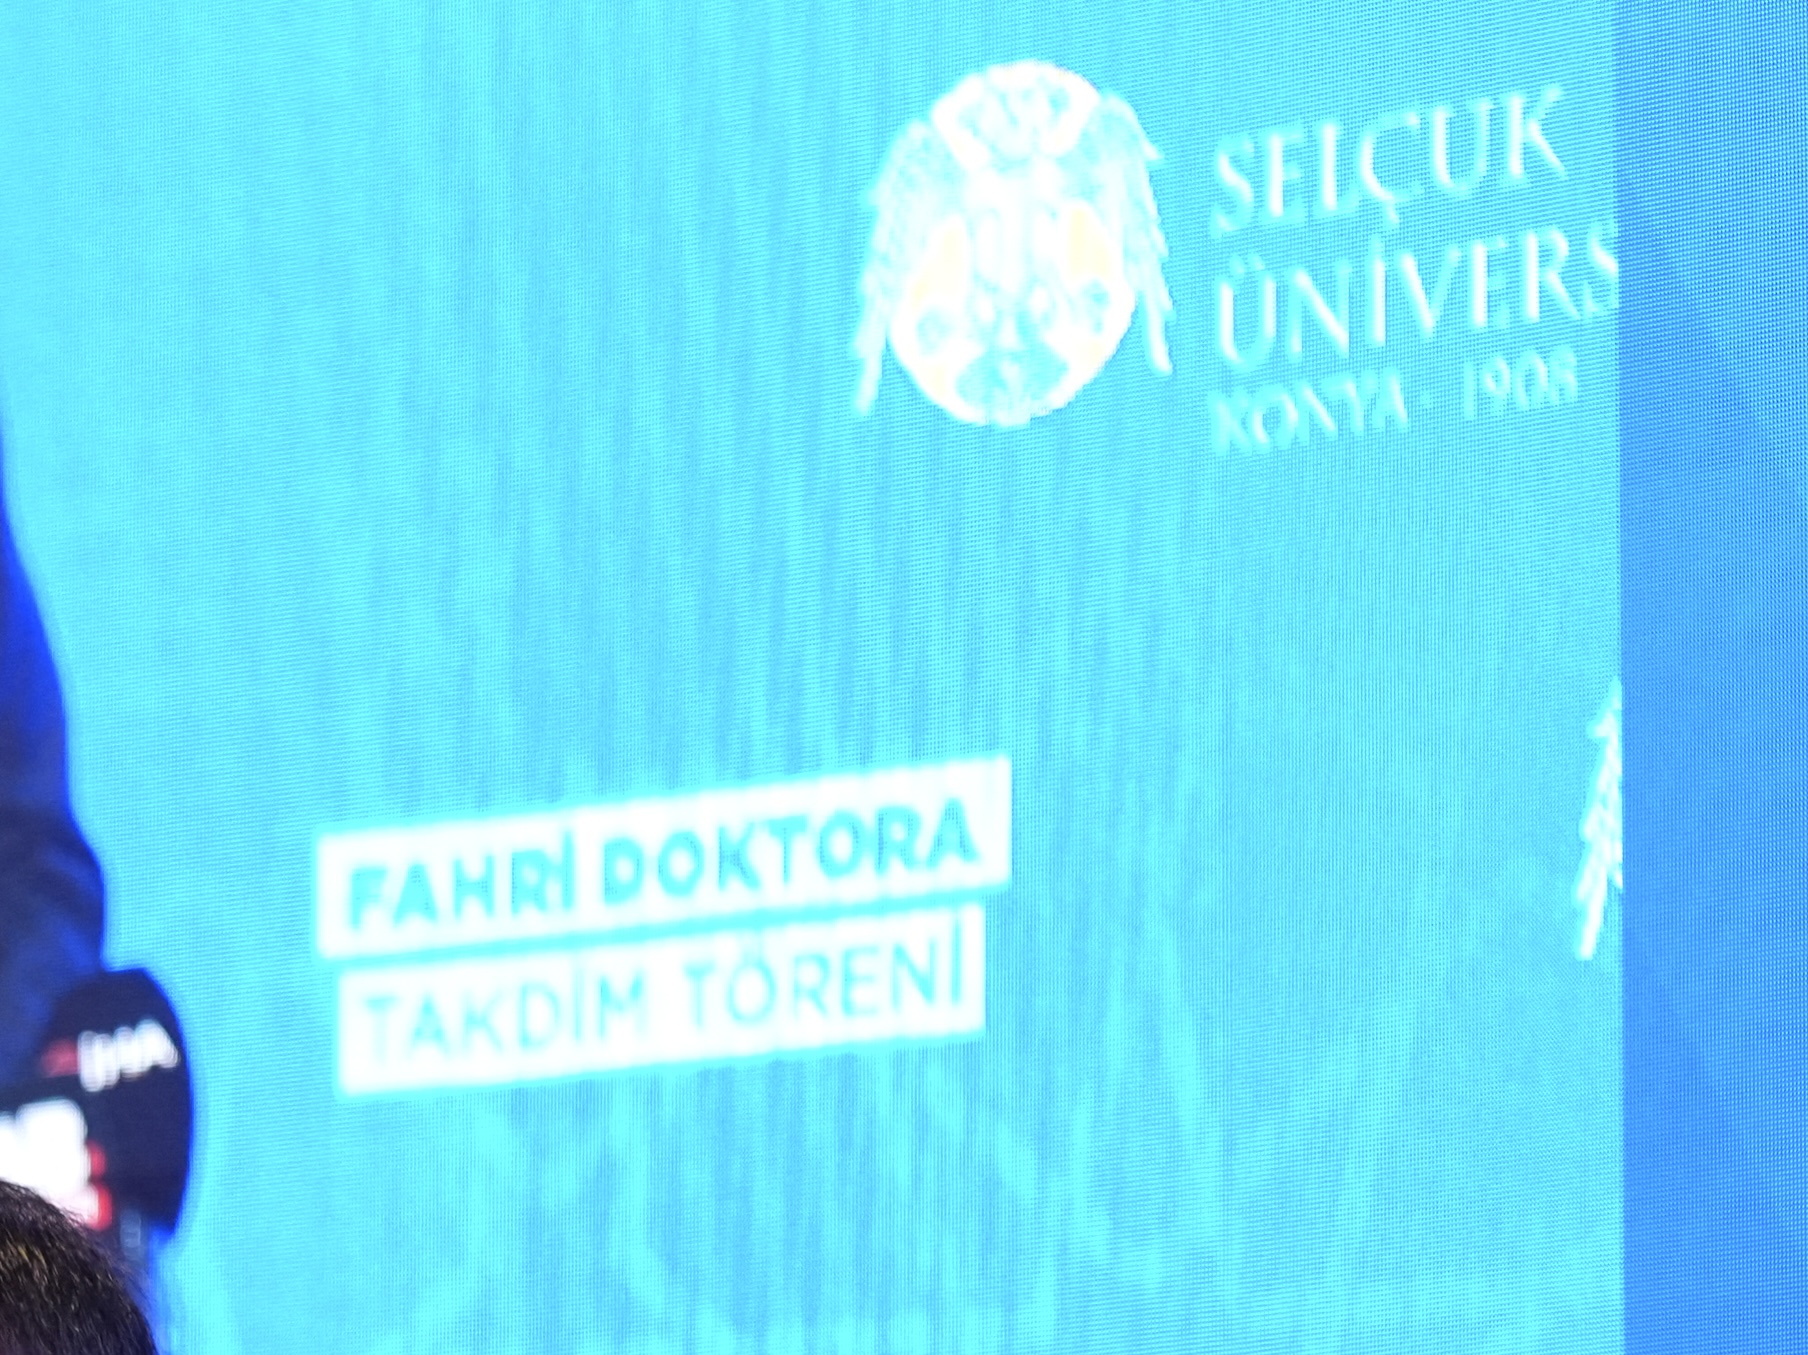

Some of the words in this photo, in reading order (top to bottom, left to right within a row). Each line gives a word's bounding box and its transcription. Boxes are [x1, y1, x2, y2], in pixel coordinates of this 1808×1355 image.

[1210, 84, 1567, 240] SELÇUK
[1208, 366, 1408, 456] KONYA
[348, 830, 575, 930] FAHRİ
[602, 797, 978, 905] DOKTORA
[366, 955, 646, 1062] TAKDİM
[683, 915, 964, 1030] TÖRENİ
